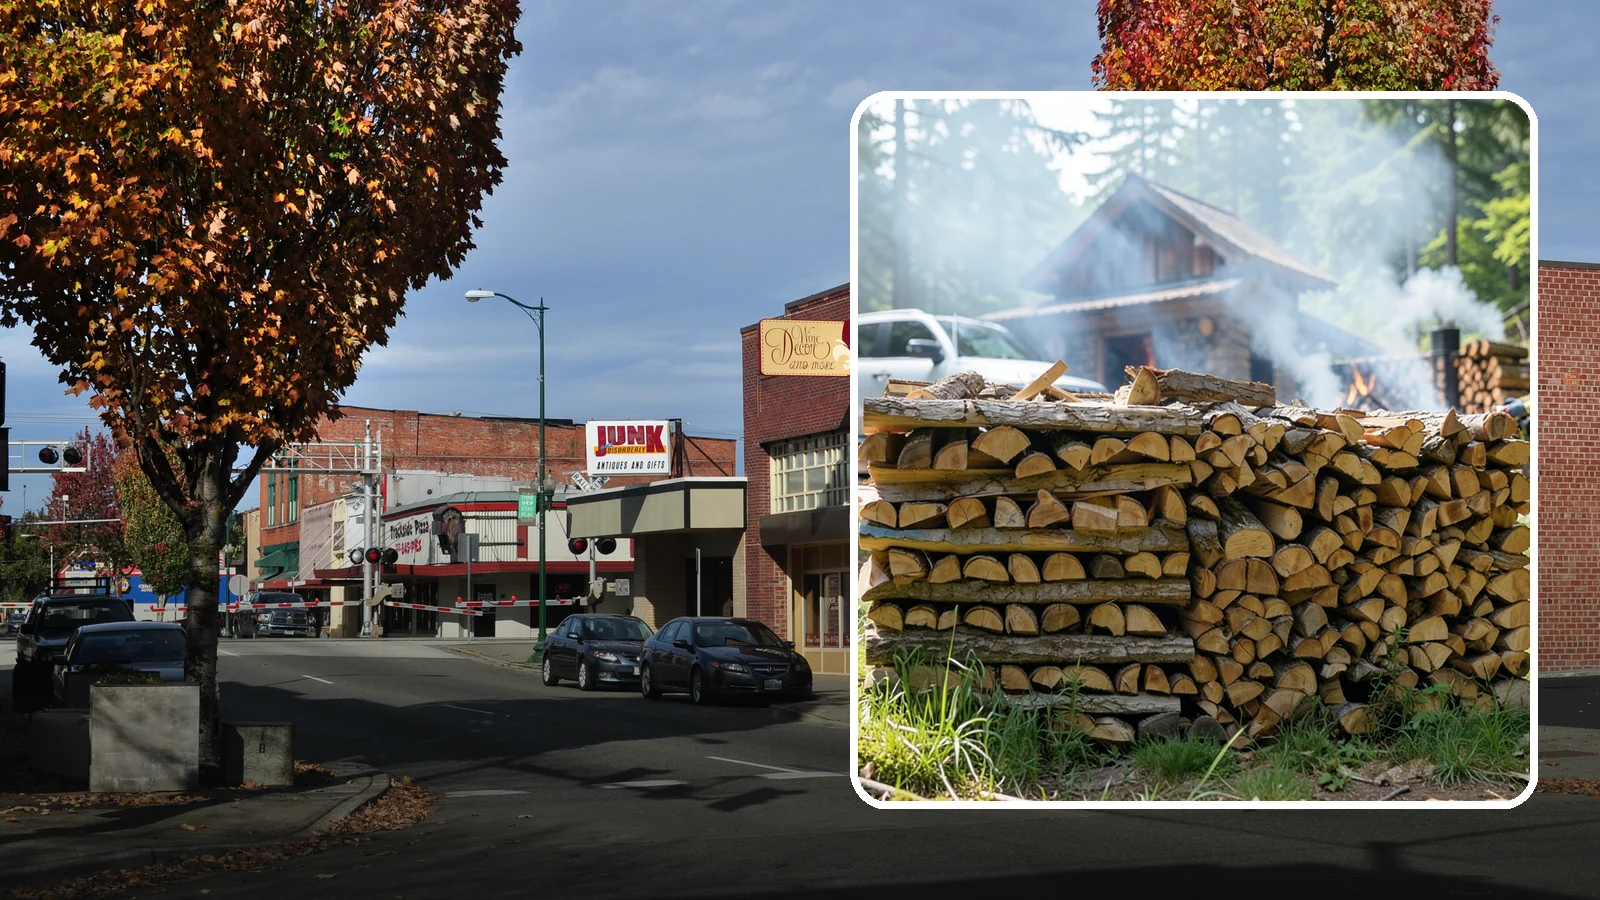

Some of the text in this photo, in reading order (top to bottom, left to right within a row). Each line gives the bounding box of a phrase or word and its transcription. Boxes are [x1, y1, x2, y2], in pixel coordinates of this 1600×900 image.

[595, 425, 665, 457] JUNK
[607, 446, 646, 454] DISORDERLY
[596, 460, 666, 470] ANTIQUES AND GIFTS
[414, 519, 429, 535] Pizza
